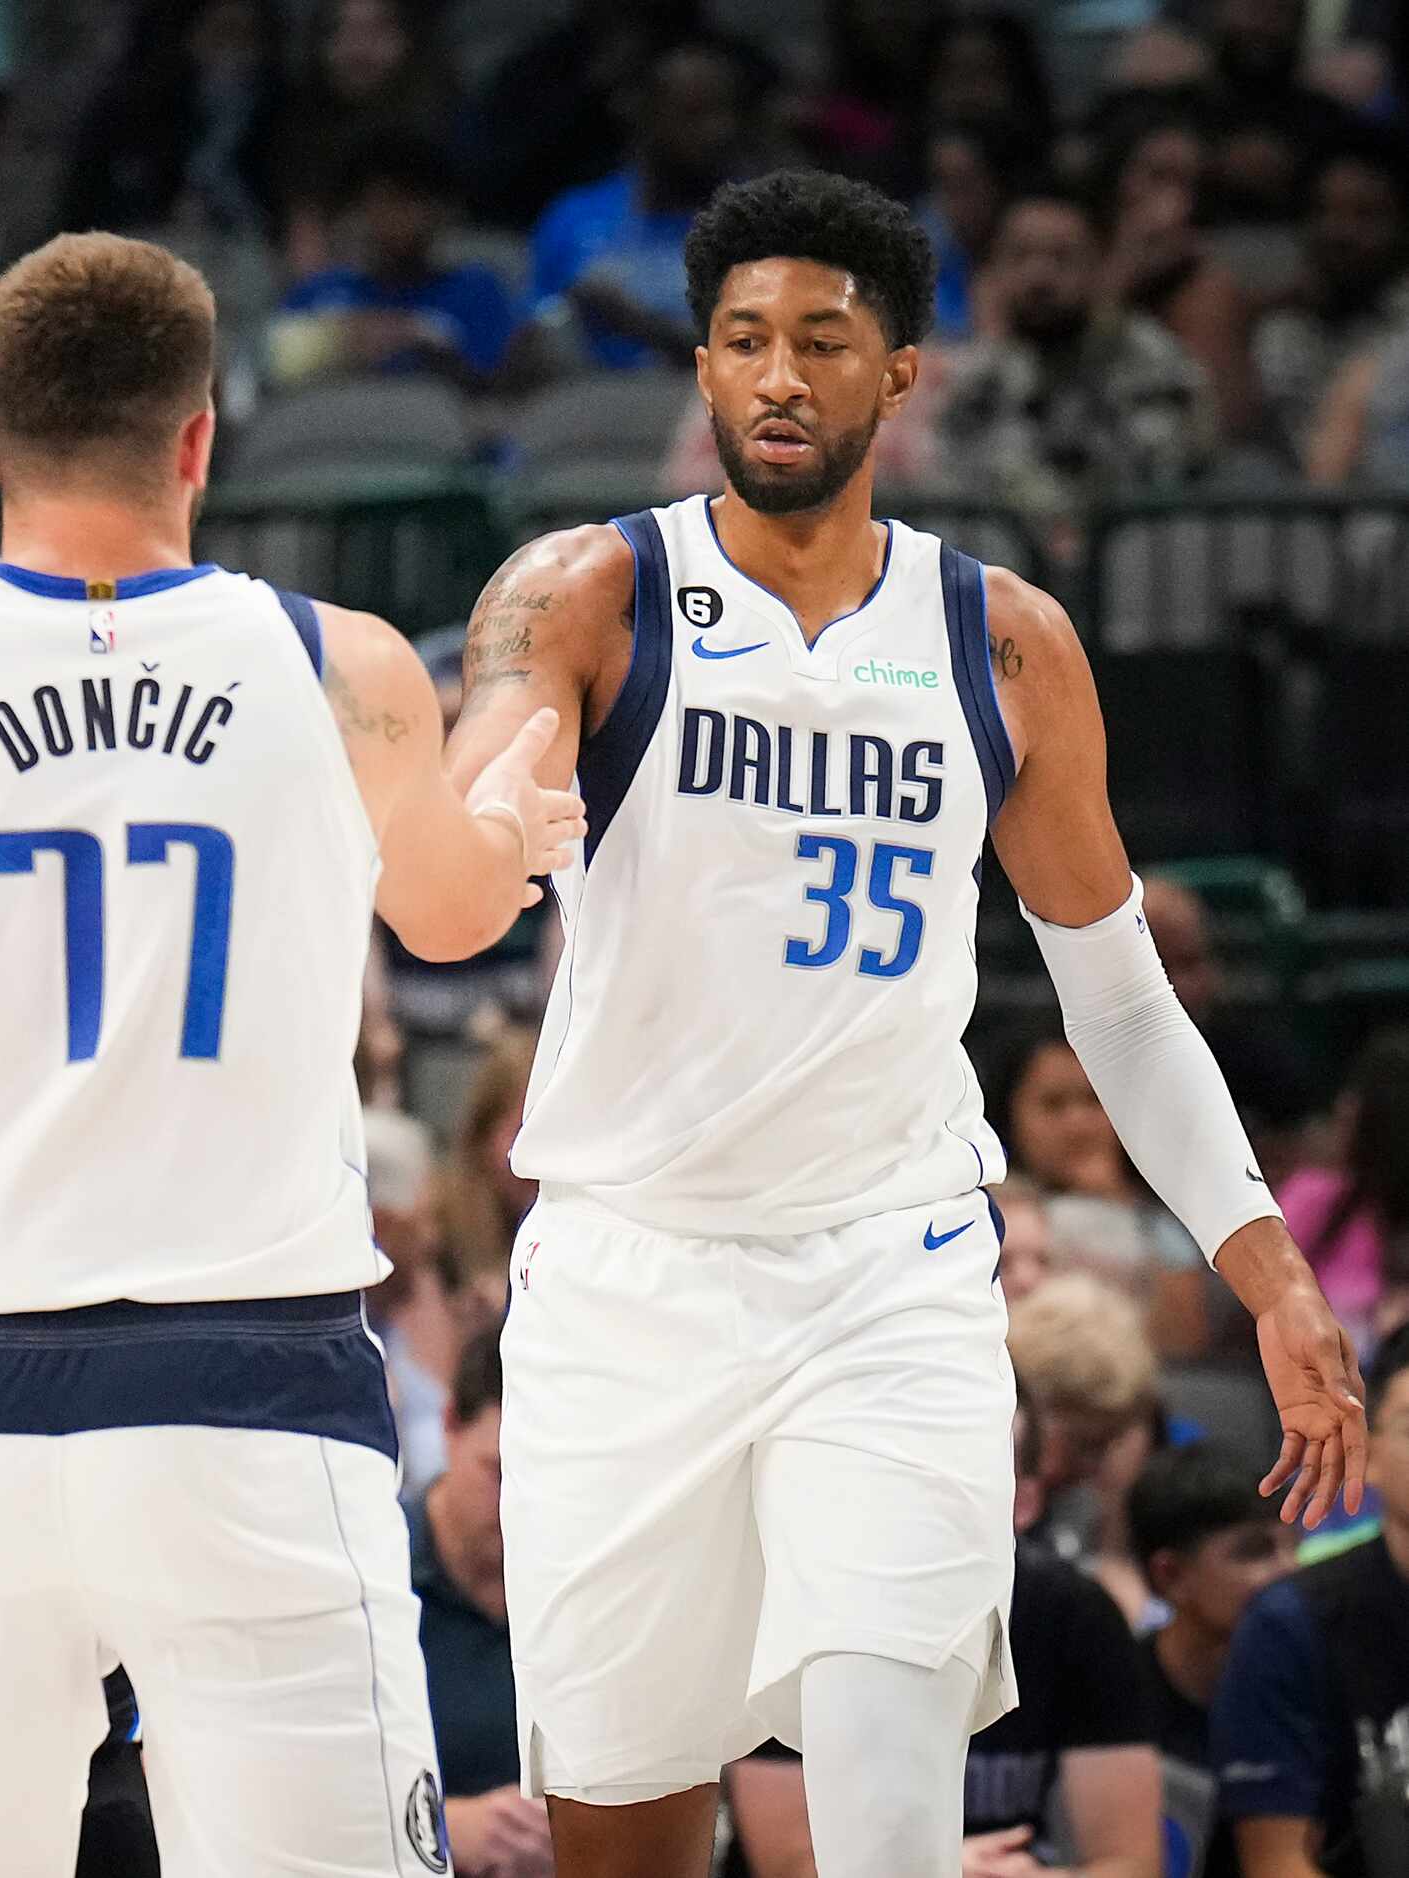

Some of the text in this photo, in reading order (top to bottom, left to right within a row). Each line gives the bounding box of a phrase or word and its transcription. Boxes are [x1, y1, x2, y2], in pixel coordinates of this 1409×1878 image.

[685, 591, 712, 624] 6
[853, 659, 940, 689] chime
[674, 705, 946, 826] DALLAS
[782, 831, 936, 982] 35
